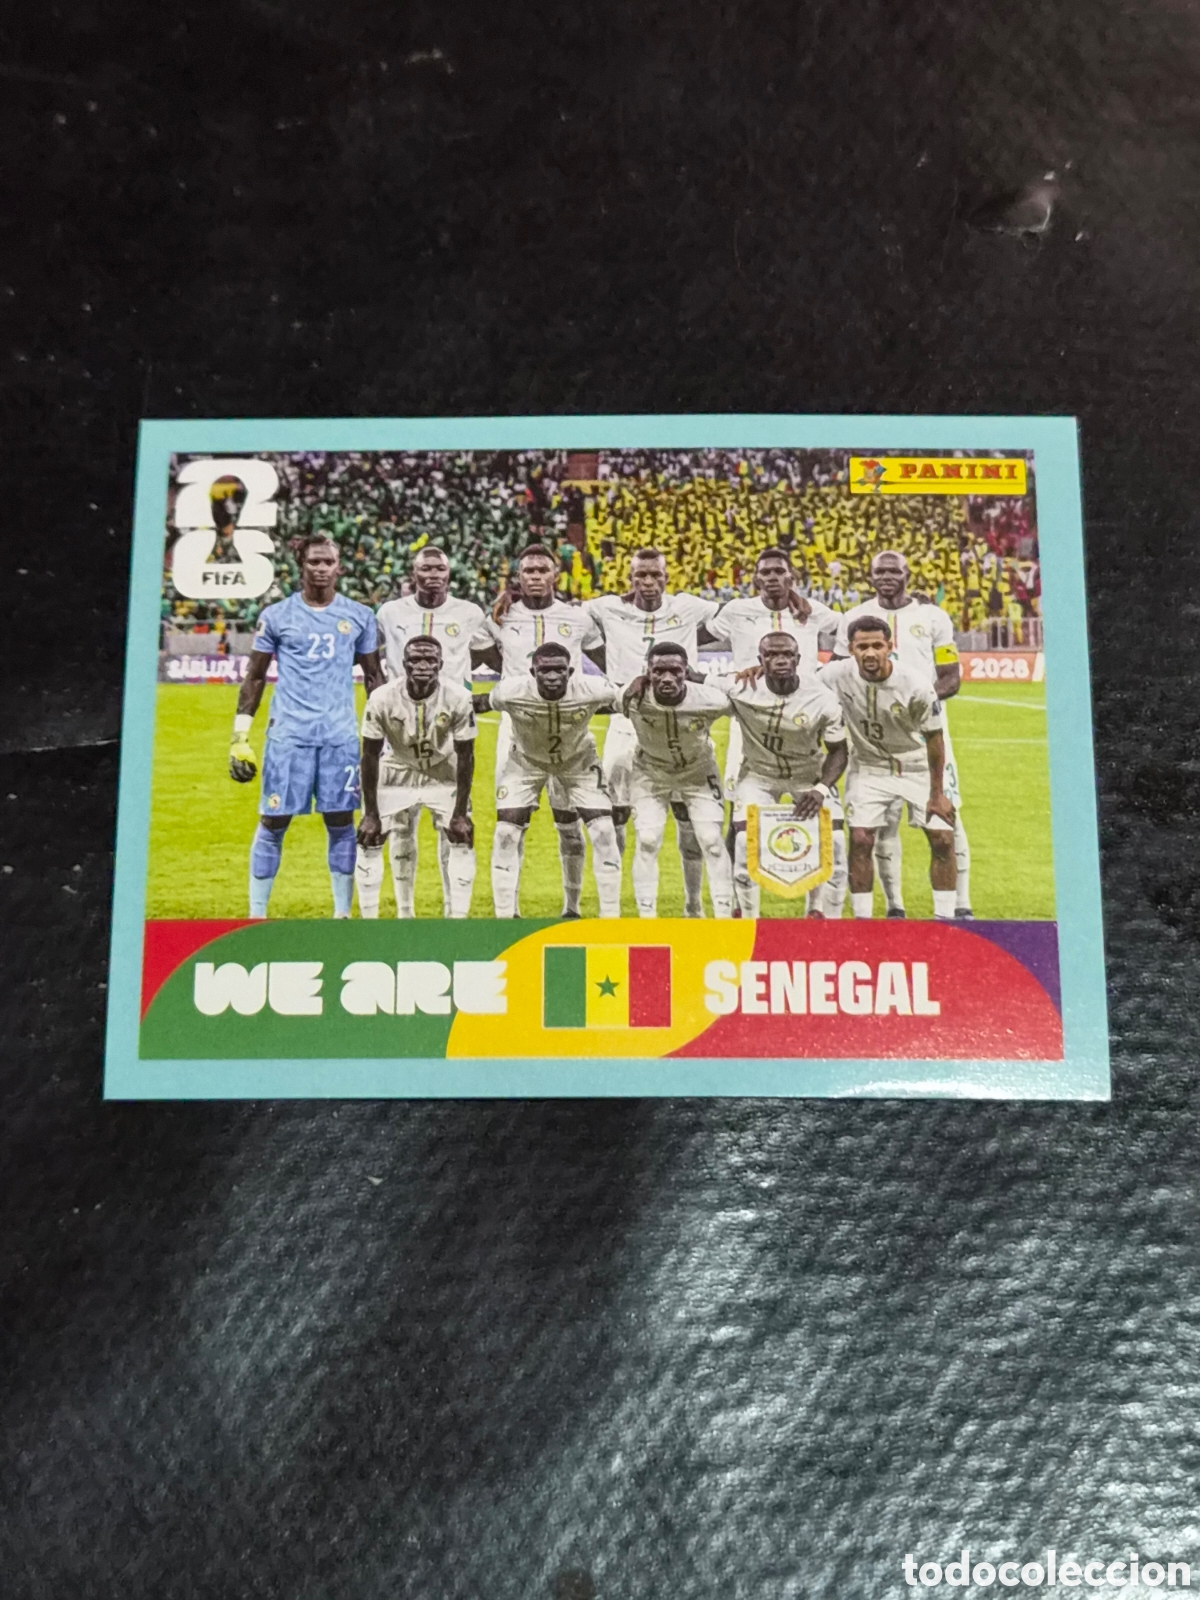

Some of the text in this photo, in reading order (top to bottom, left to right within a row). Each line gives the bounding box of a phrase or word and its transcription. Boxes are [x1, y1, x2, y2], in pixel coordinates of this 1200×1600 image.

[899, 463, 1018, 479] PANINI
[202, 571, 247, 586] FIFA
[308, 633, 335, 660] 23
[859, 720, 884, 741] 13
[548, 736, 563, 754] 2
[668, 739, 682, 754] 5
[590, 765, 608, 789] 2
[706, 775, 721, 800] 5
[194, 961, 324, 1016] WE
[703, 961, 940, 1016] SENEGAL
